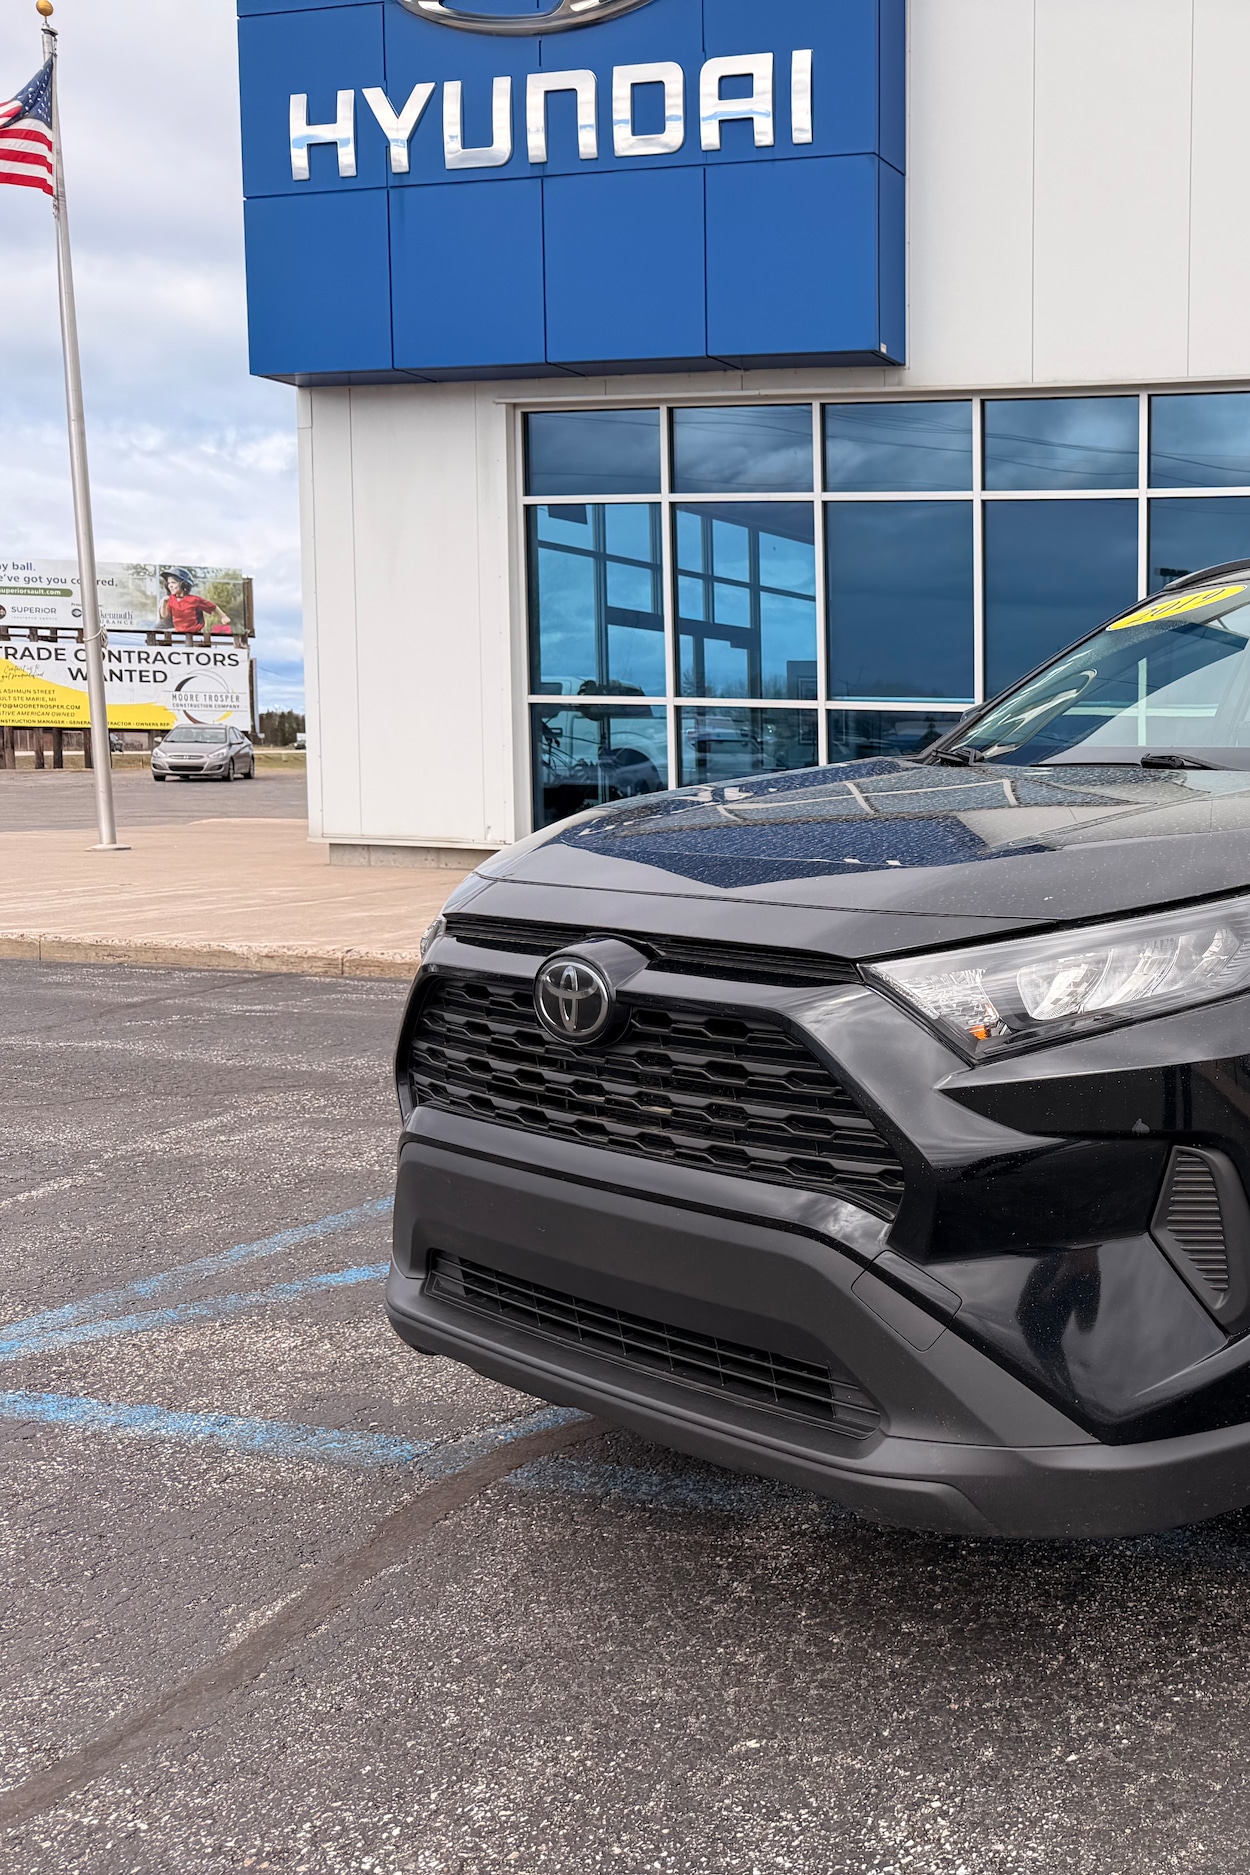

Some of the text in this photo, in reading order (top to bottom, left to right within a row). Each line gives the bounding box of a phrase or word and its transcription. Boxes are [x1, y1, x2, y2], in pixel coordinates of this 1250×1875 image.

[289, 48, 812, 181] HYUNDAI
[12, 561, 36, 571] ball.
[23, 575, 43, 584] got
[46, 576, 67, 586] you
[11, 606, 57, 615] SUPERIOR
[67, 667, 168, 683] WNTED
[171, 693, 240, 703] MOORE TROSPER
